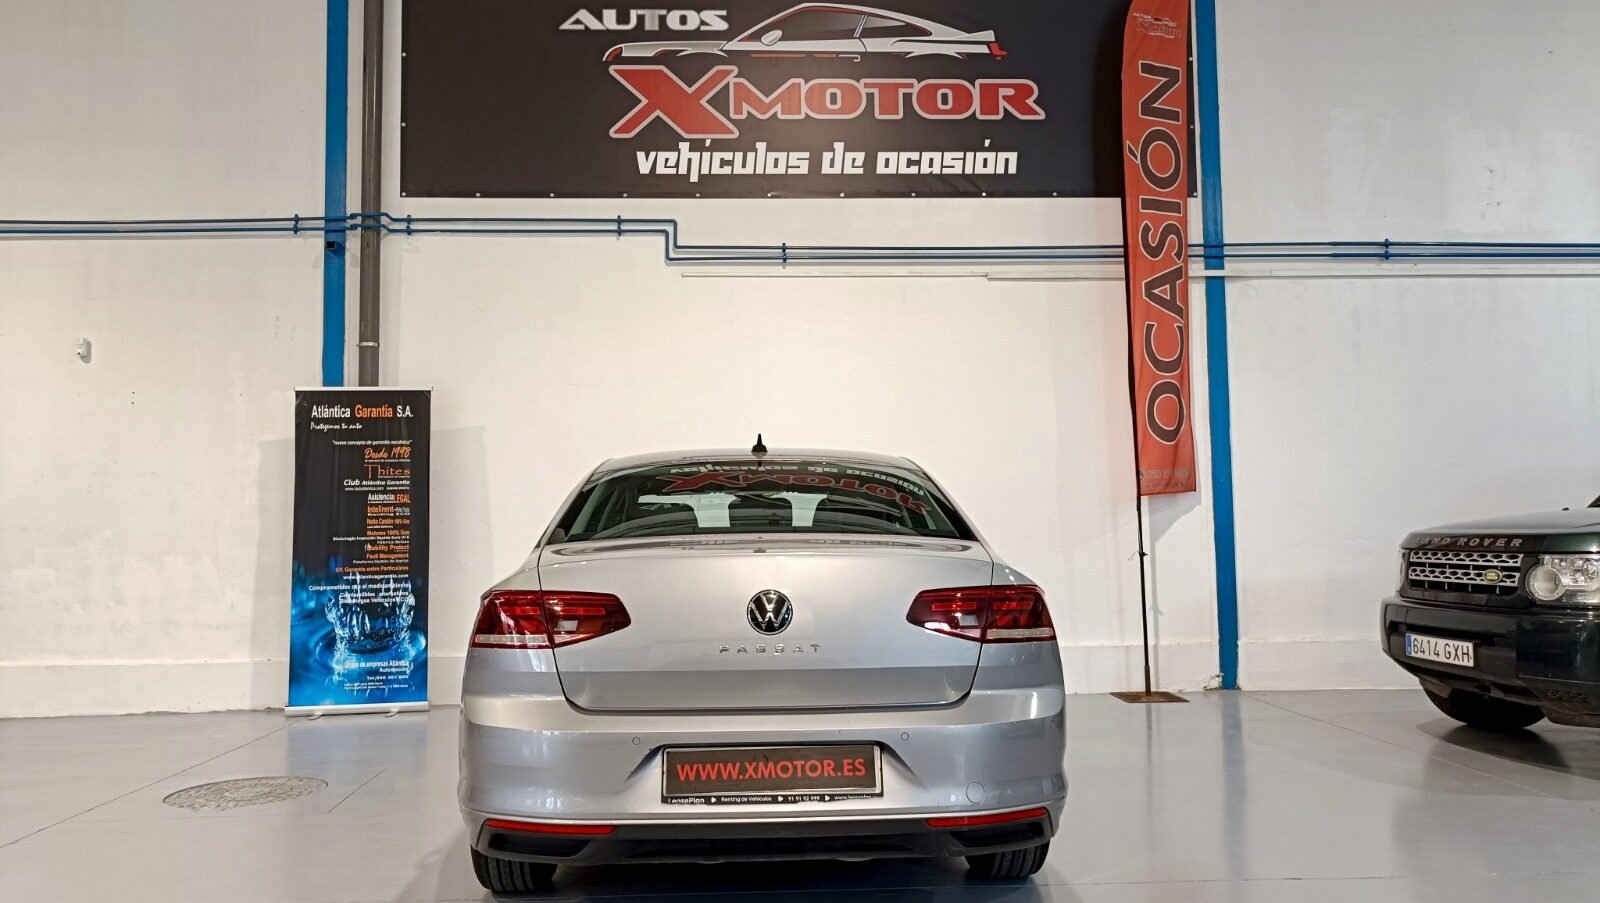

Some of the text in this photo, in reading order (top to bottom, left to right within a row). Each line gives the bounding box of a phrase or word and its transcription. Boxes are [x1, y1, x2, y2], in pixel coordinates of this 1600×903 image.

[558, 8, 730, 31] AUTOS
[608, 64, 1046, 139] XMOTOR
[636, 139, 1017, 183] vehículos de ocasión
[1127, 60, 1187, 445] OCASIÓN
[311, 404, 414, 418] Atlántica Garantía S.A.
[364, 447, 388, 459] Desde
[364, 464, 410, 479] Thites
[1456, 538, 1522, 547] ROVER
[720, 644, 820, 655] PASSAT
[1412, 638, 1471, 663] 6414 GXH
[676, 758, 866, 782] WWW.XMOTOR.ES
